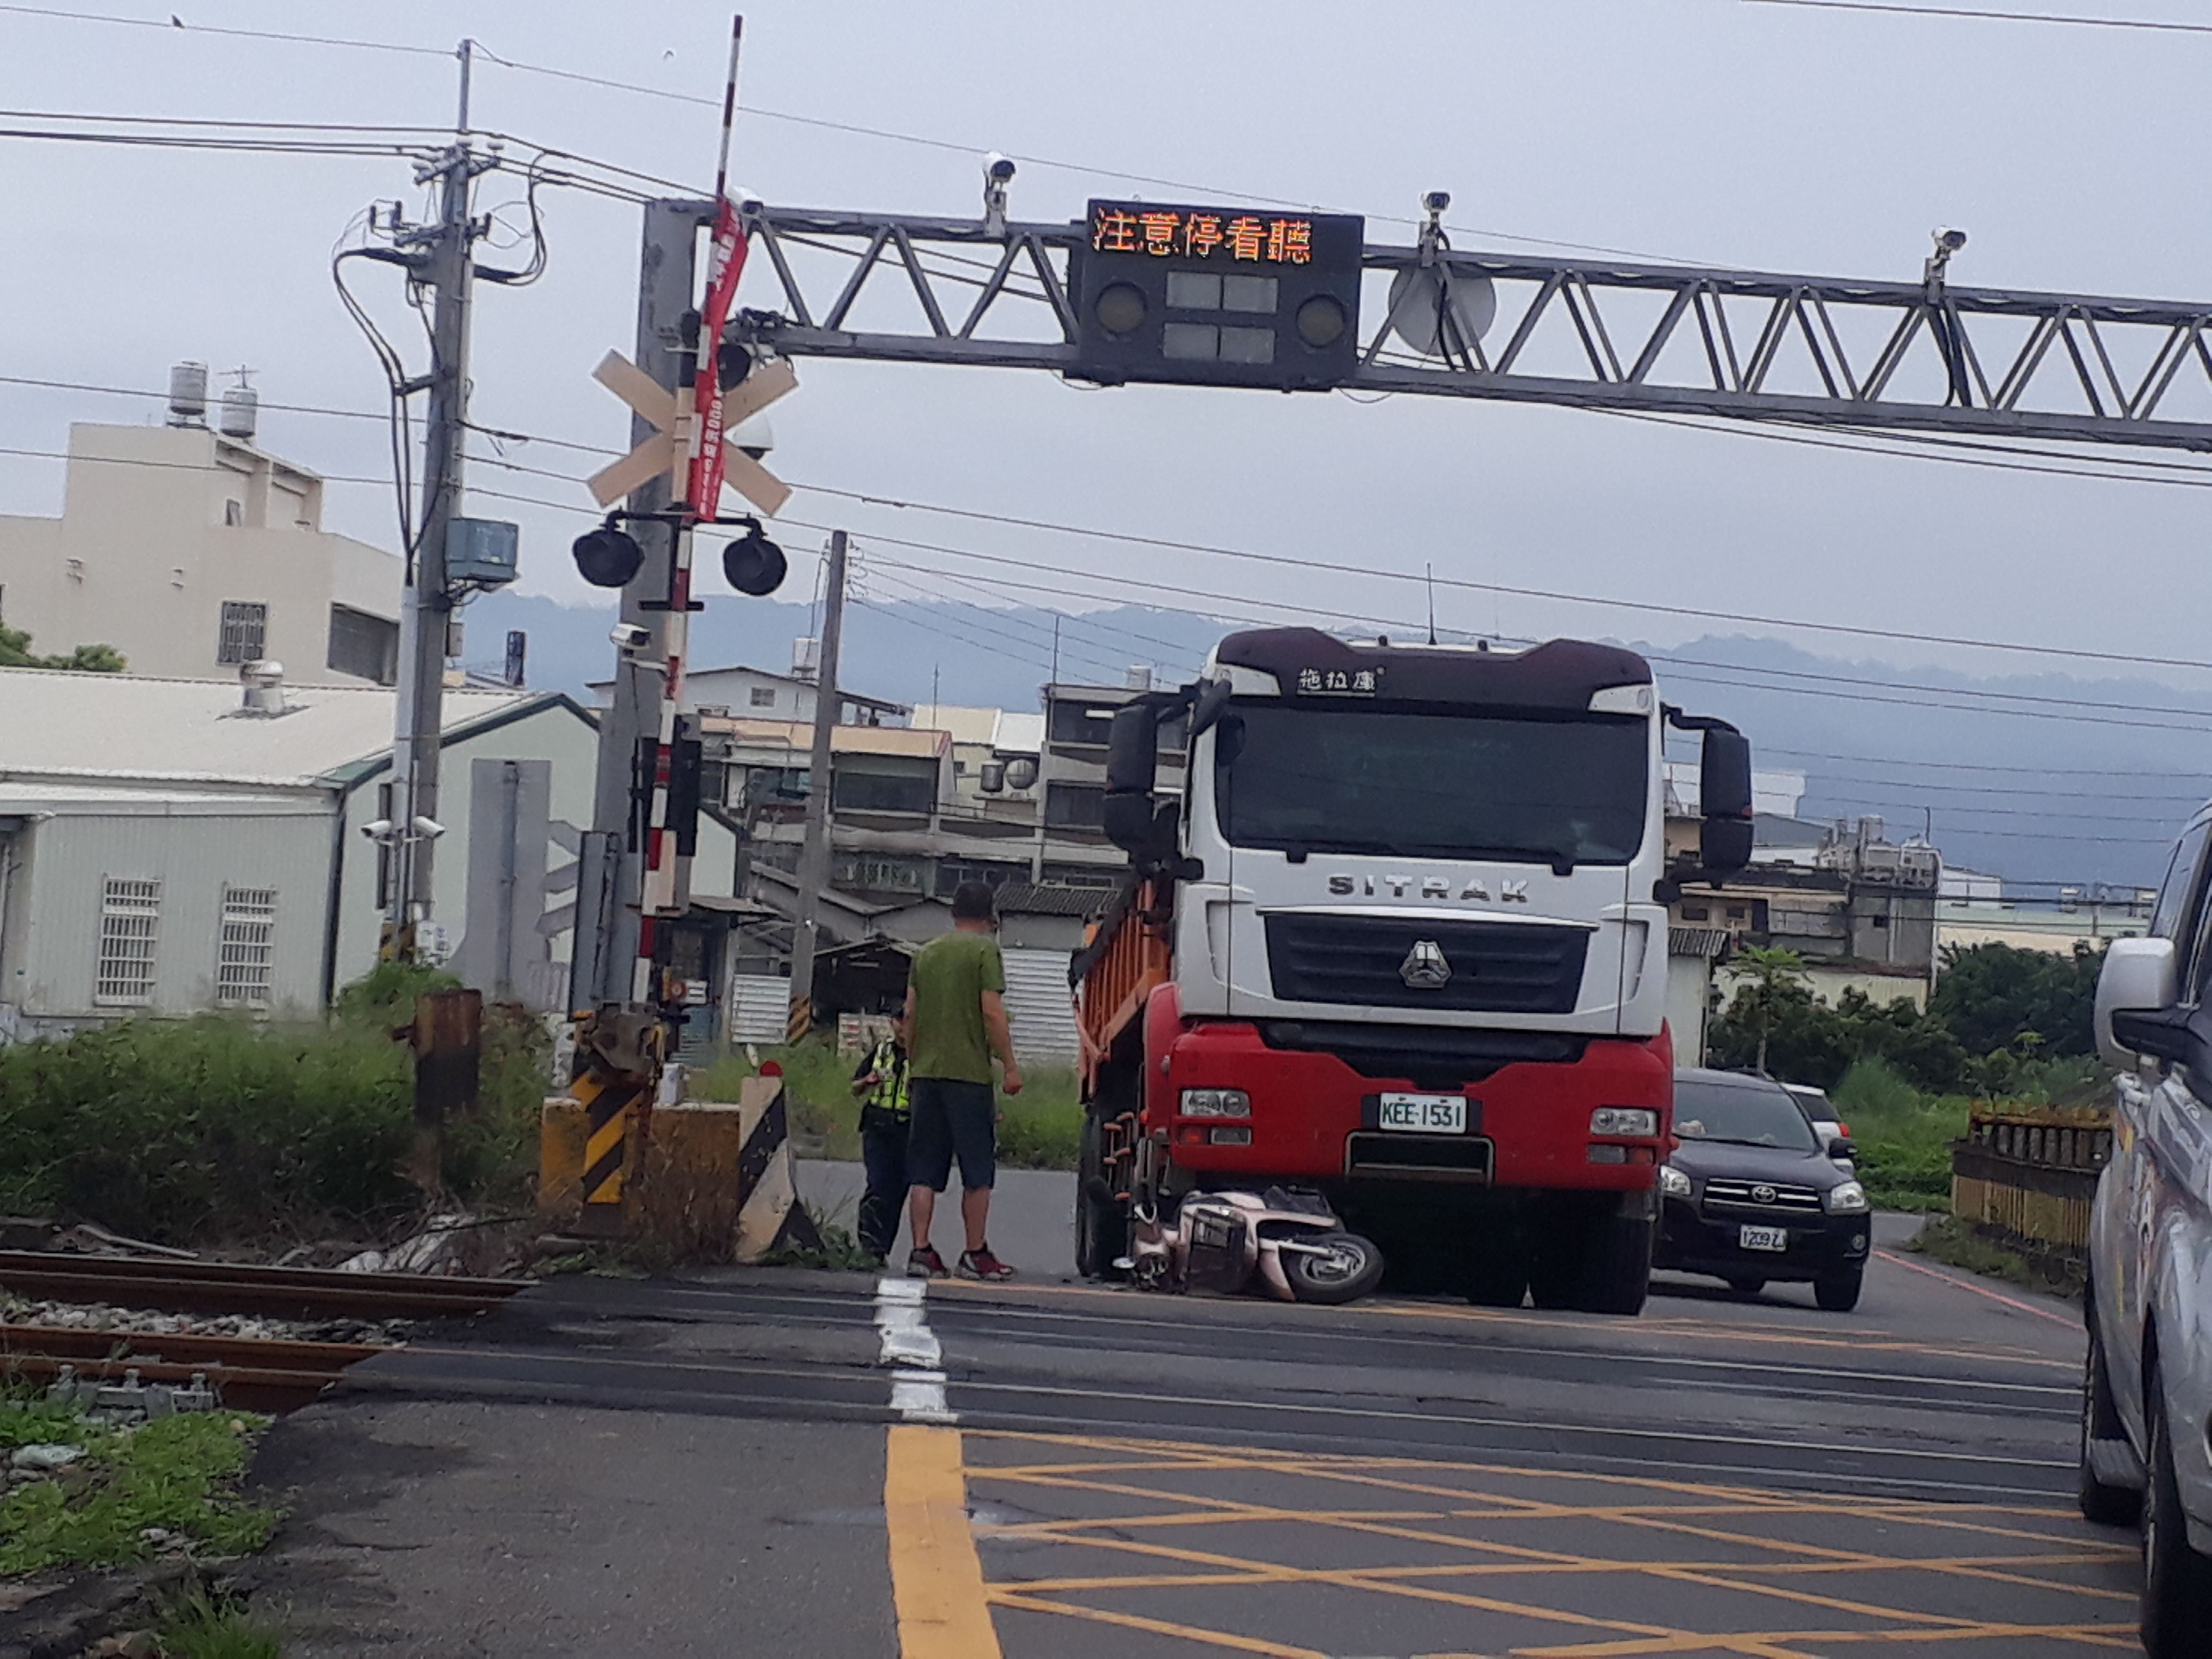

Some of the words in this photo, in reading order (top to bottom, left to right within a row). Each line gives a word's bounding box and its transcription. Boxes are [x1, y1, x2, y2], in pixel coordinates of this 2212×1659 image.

[1092, 207, 1312, 265] 注意停看聽
[1328, 873, 1528, 903] SITRAK
